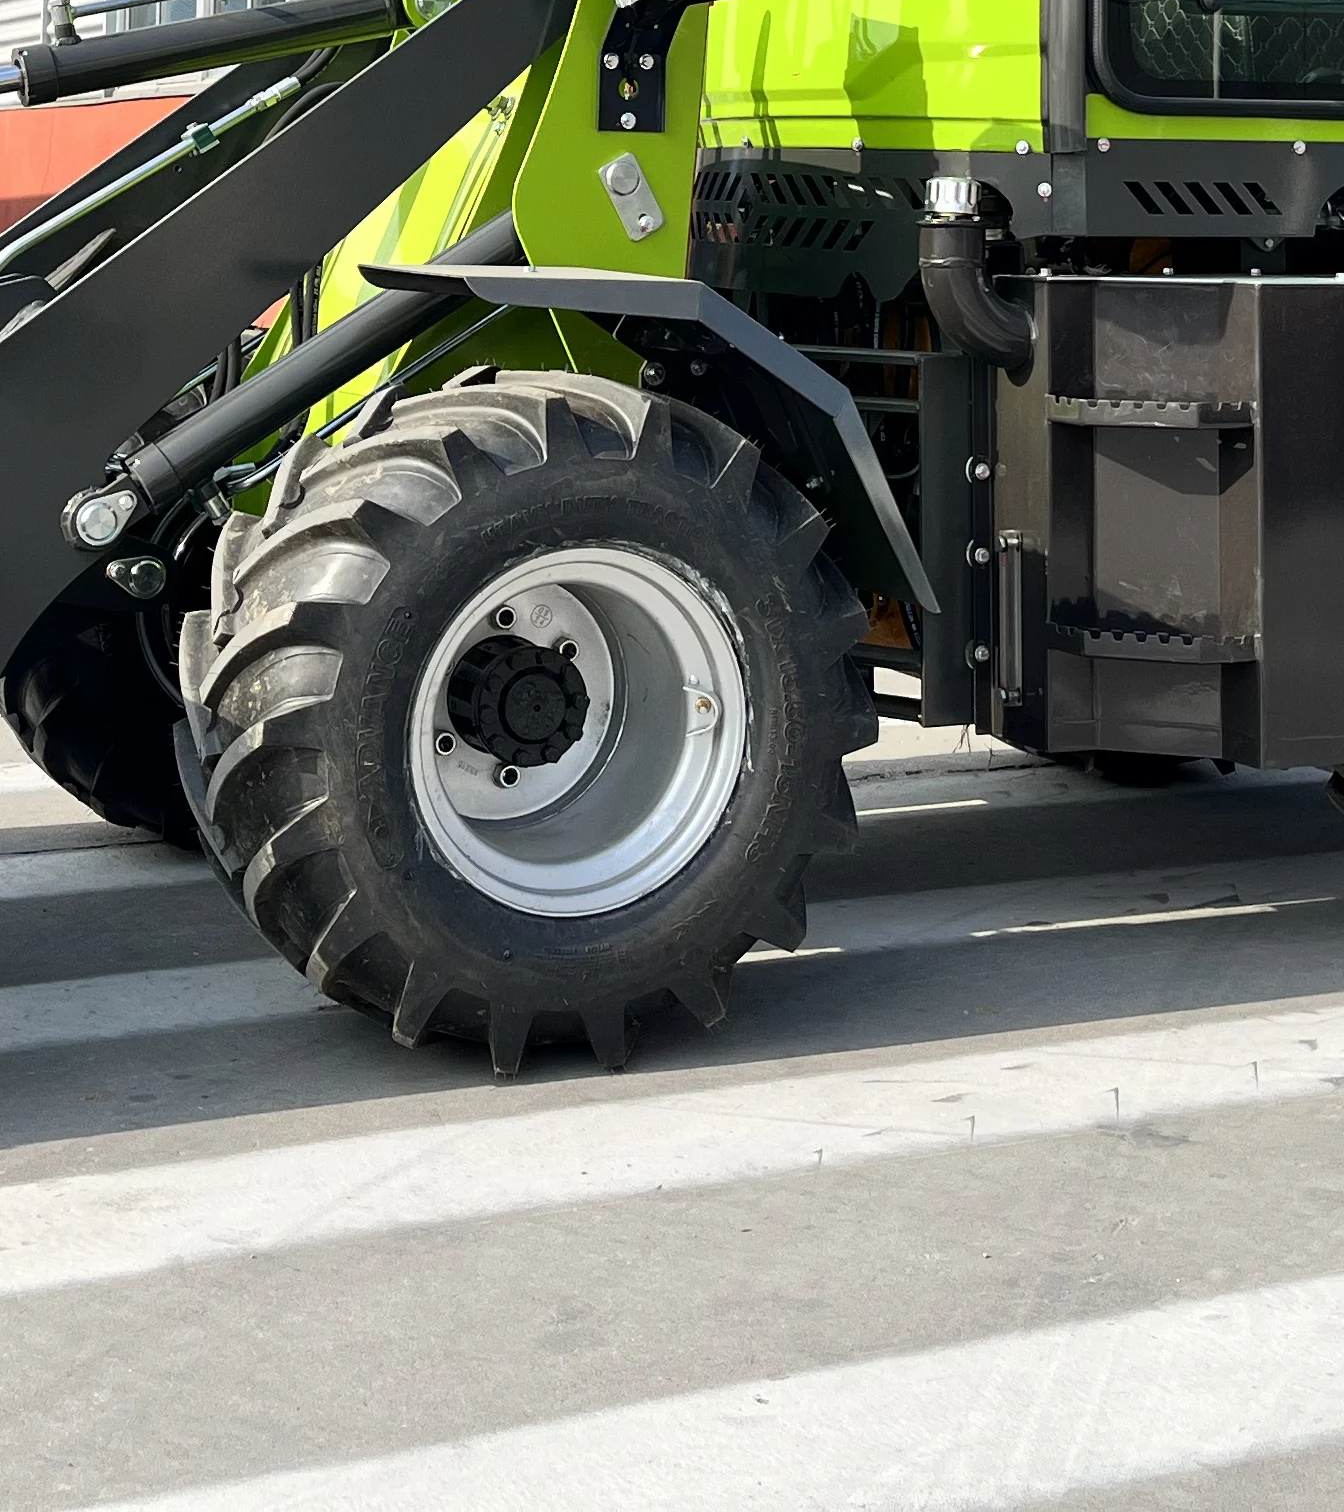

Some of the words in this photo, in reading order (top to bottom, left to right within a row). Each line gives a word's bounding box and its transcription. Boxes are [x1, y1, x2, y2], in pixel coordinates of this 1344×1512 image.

[560, 495, 618, 516] DUTY
[625, 497, 720, 551] TRACTION
[356, 617, 414, 800] ADVANCE
